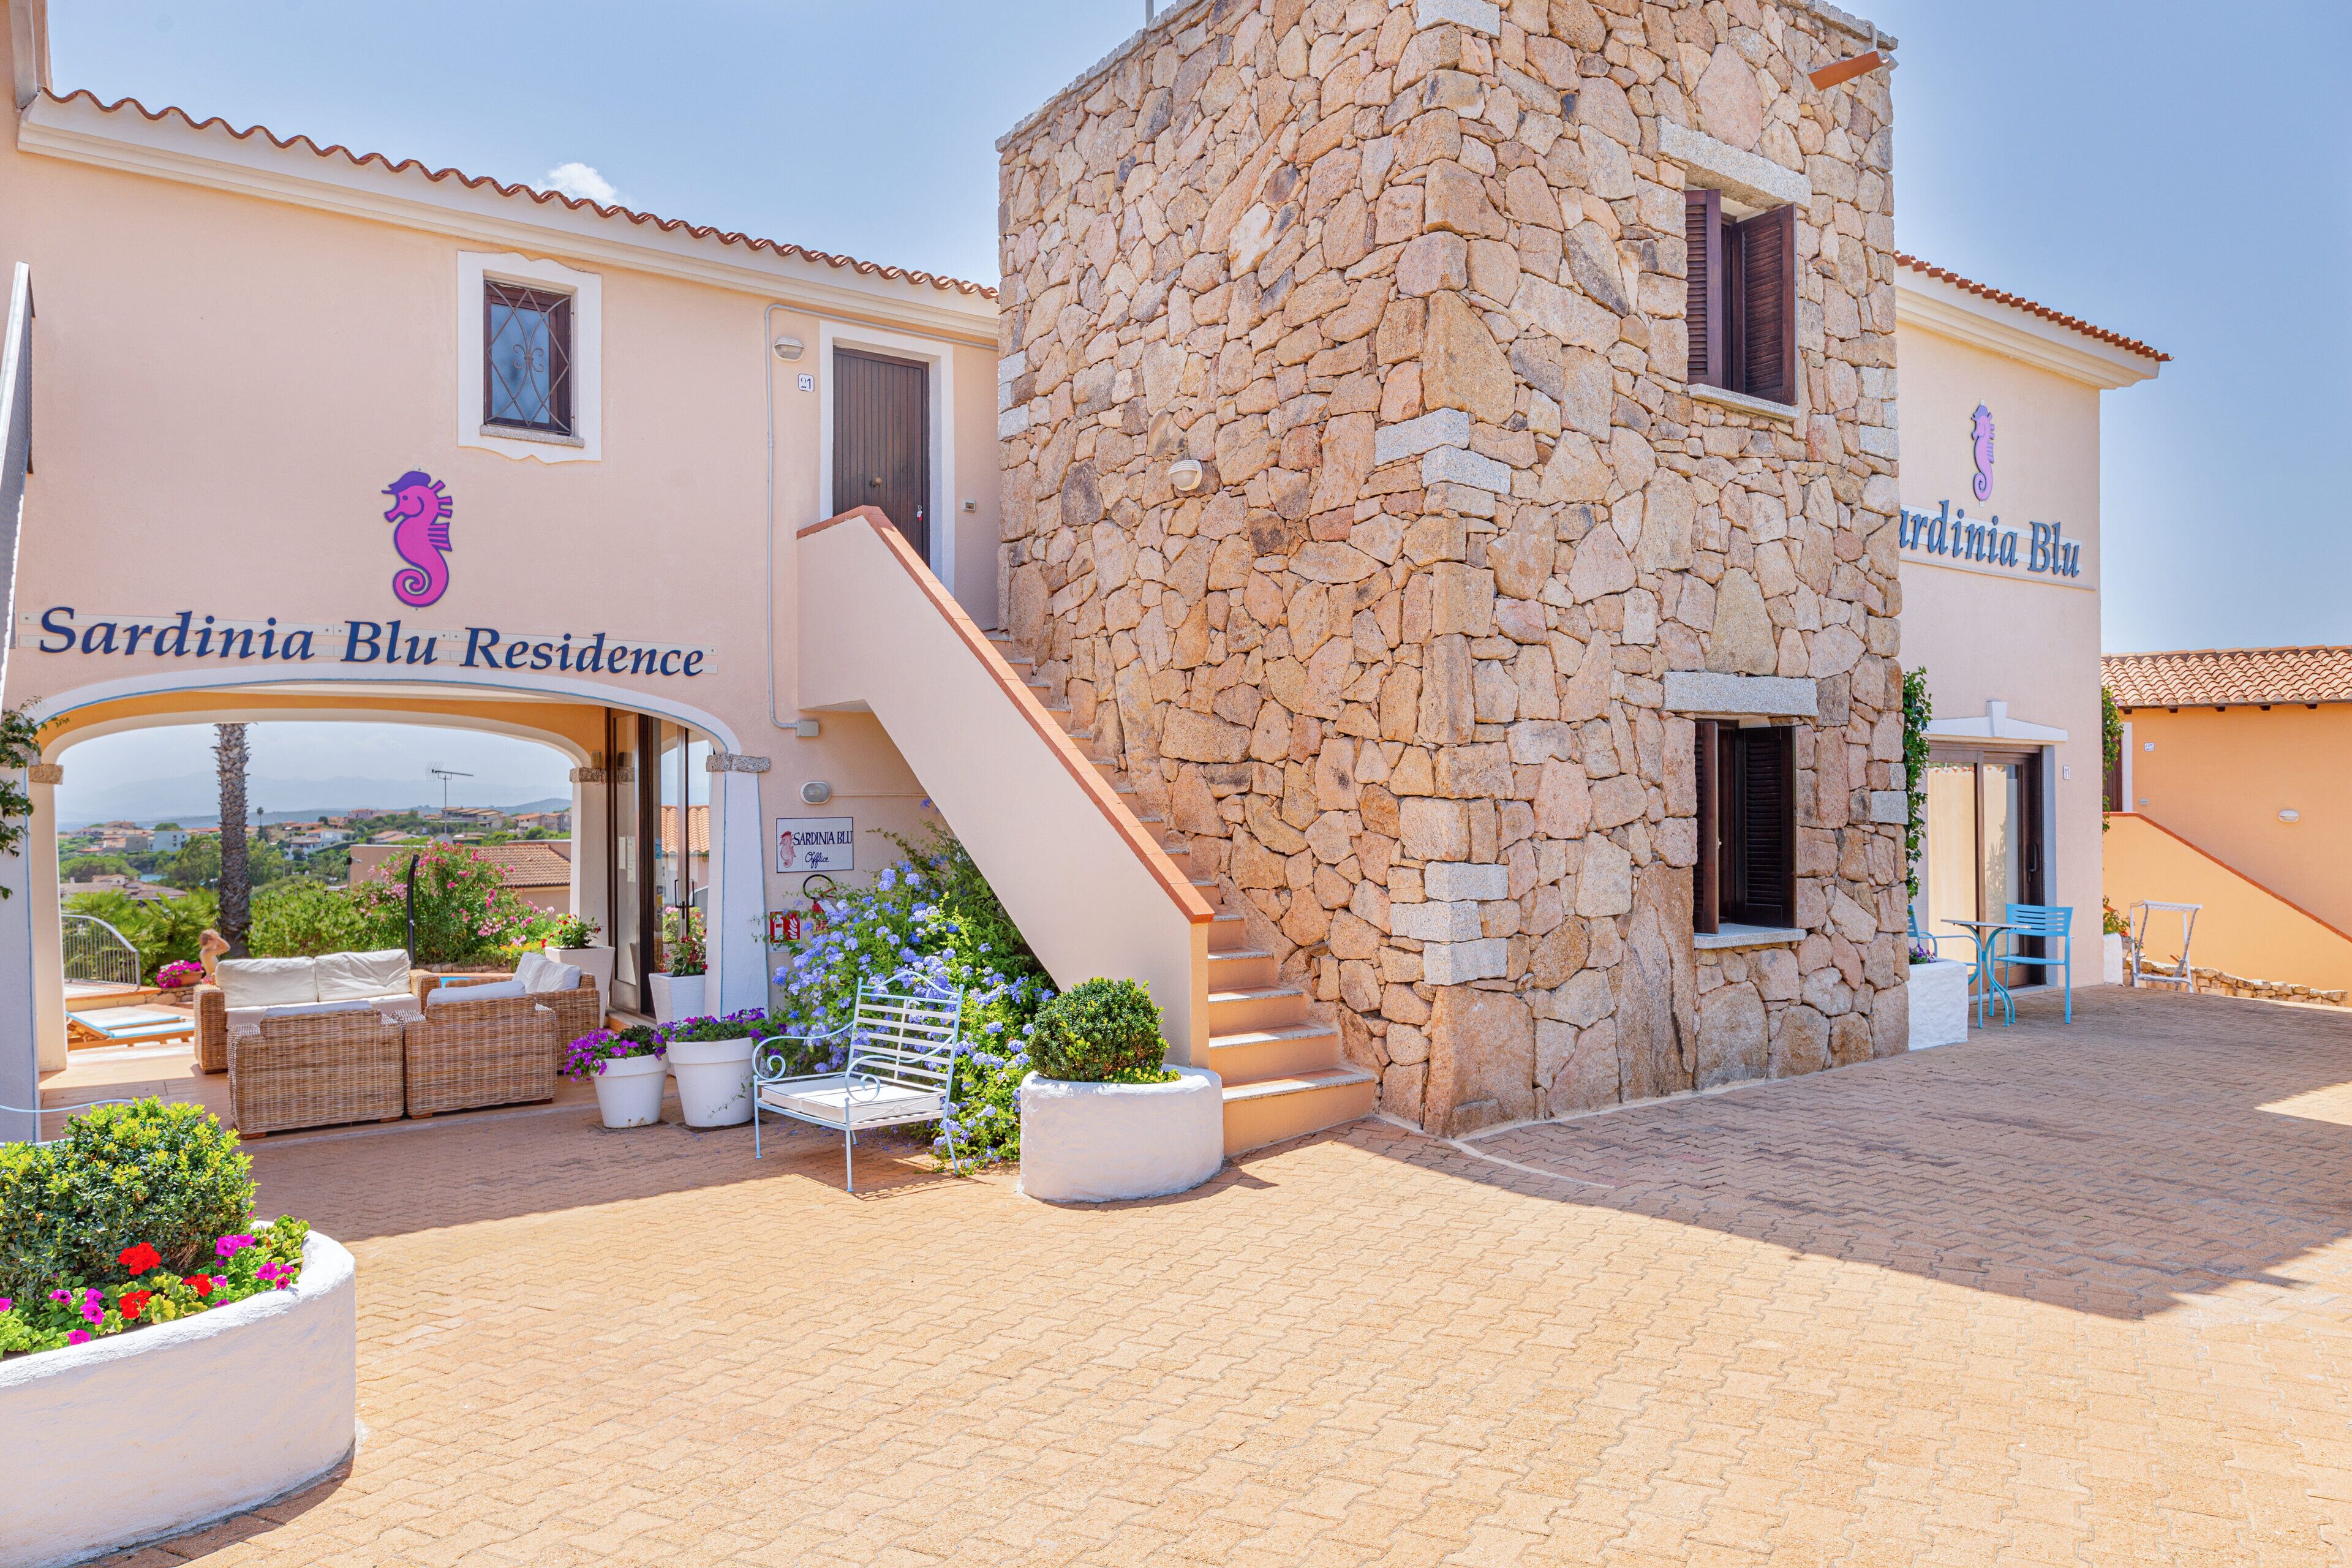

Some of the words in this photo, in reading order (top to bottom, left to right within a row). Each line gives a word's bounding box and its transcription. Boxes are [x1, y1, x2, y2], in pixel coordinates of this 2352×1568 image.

[801, 377, 811, 389] 21
[2028, 521, 2079, 578] Blu
[40, 606, 315, 660] Sardinia
[341, 619, 438, 665] Blu
[459, 627, 704, 677] Residence
[2064, 768, 2070, 778] 11
[793, 832, 835, 845] SARDINIA
[837, 831, 853, 844] BLU
[805, 851, 829, 869] Office
